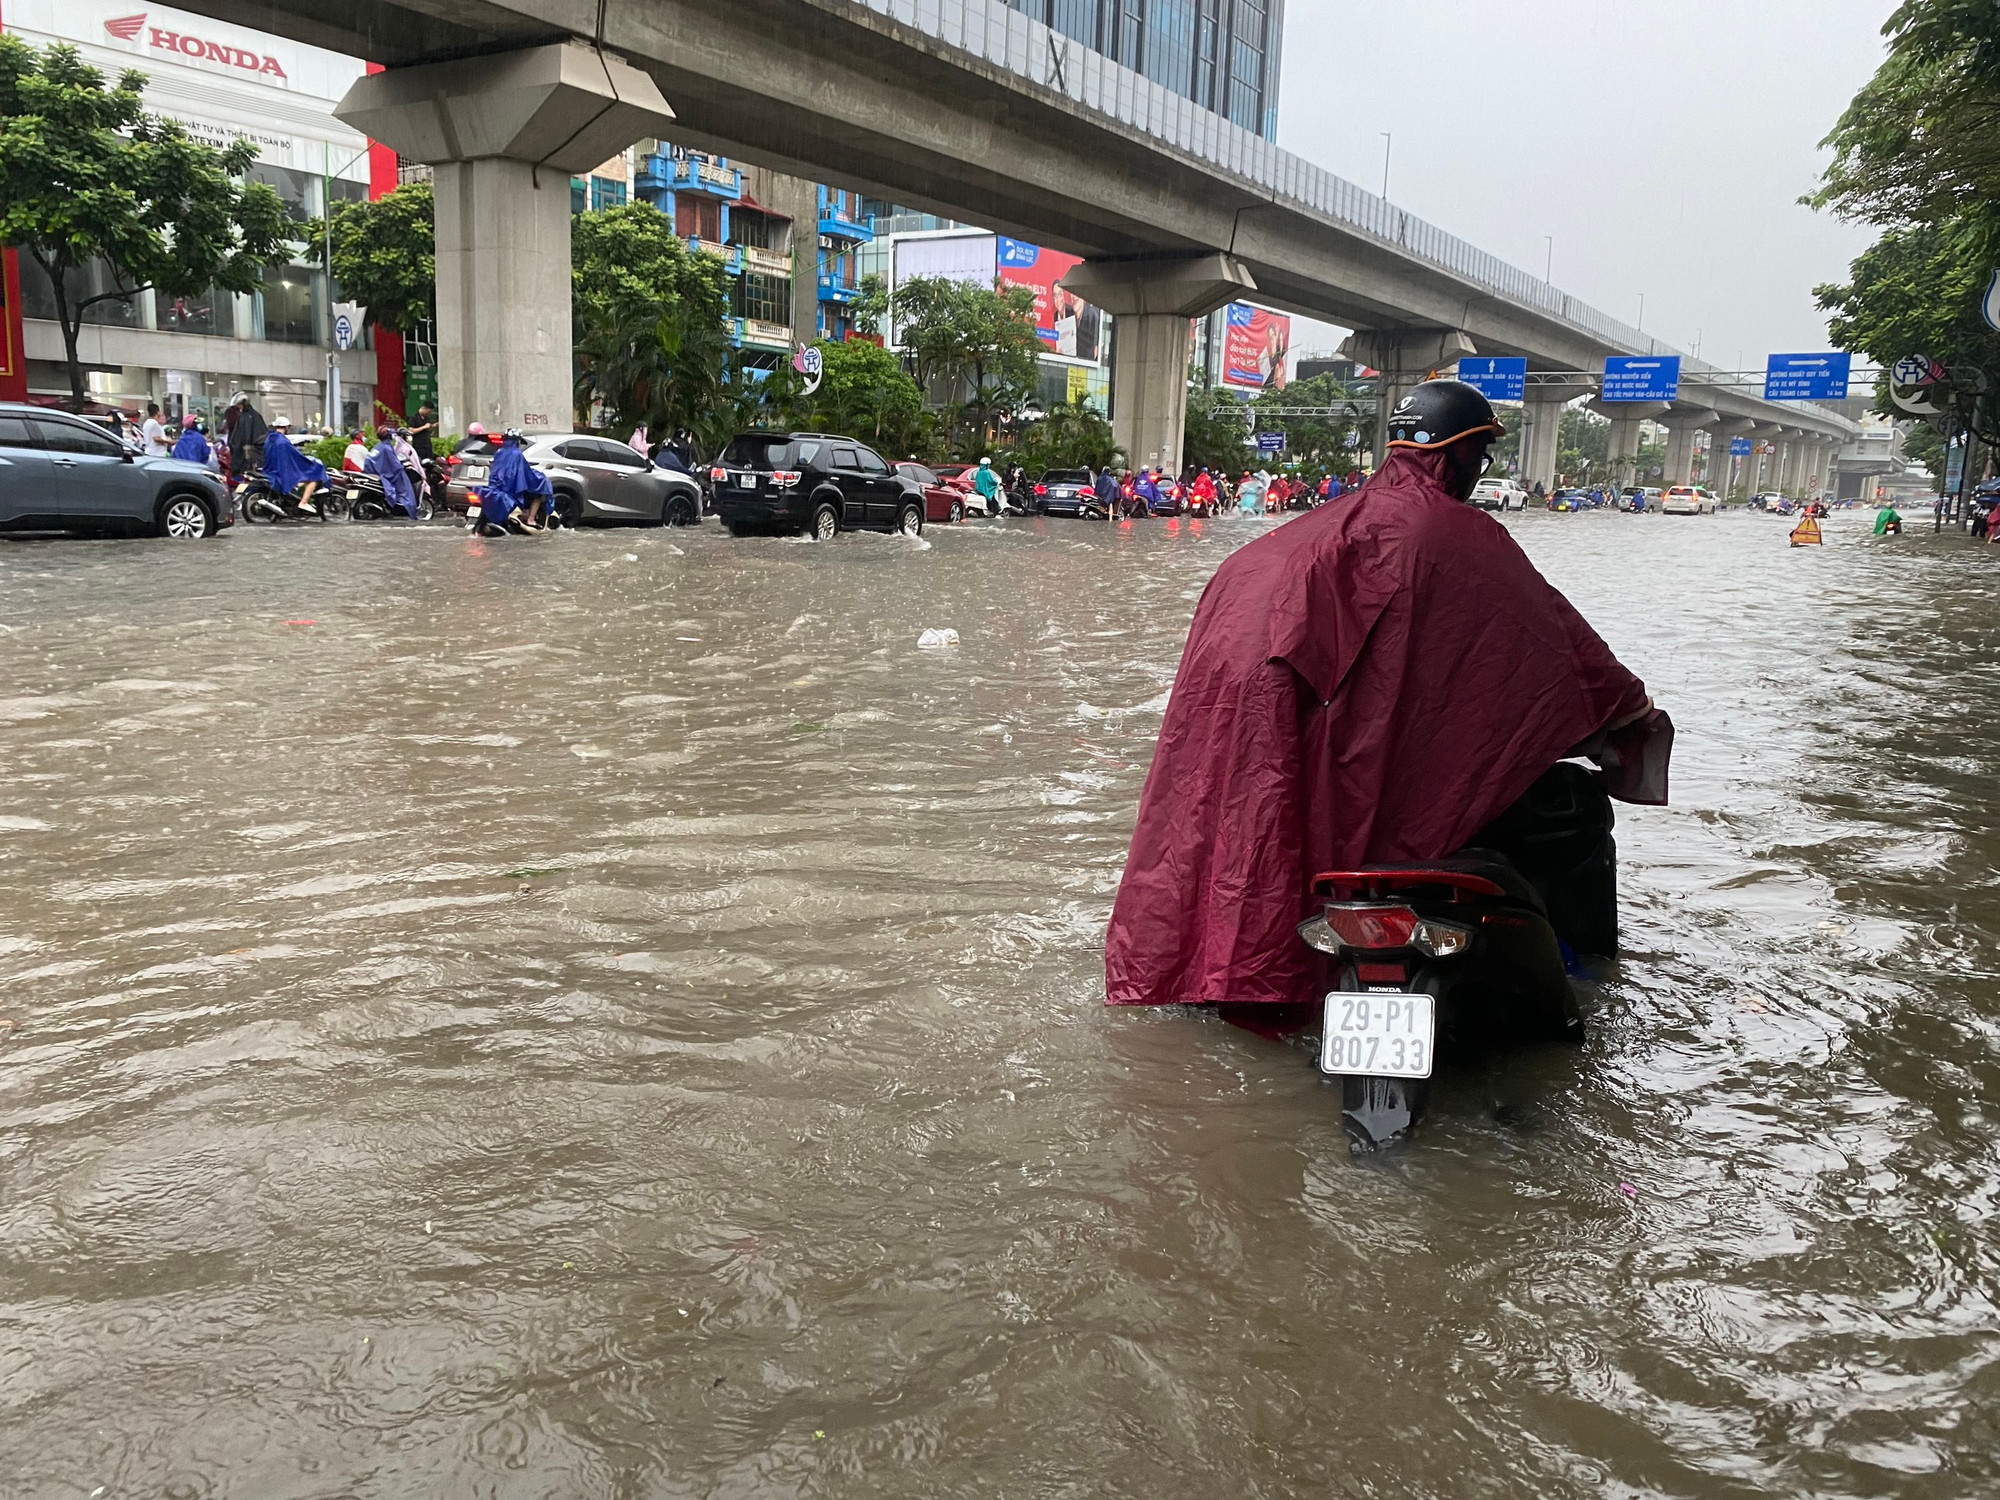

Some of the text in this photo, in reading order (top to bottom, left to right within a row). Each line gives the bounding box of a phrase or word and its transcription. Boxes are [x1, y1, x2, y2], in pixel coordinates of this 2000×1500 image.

[149, 27, 287, 78] HONDA
[1341, 999, 1414, 1033] 29-P1
[1330, 1035, 1424, 1071] 807.33
